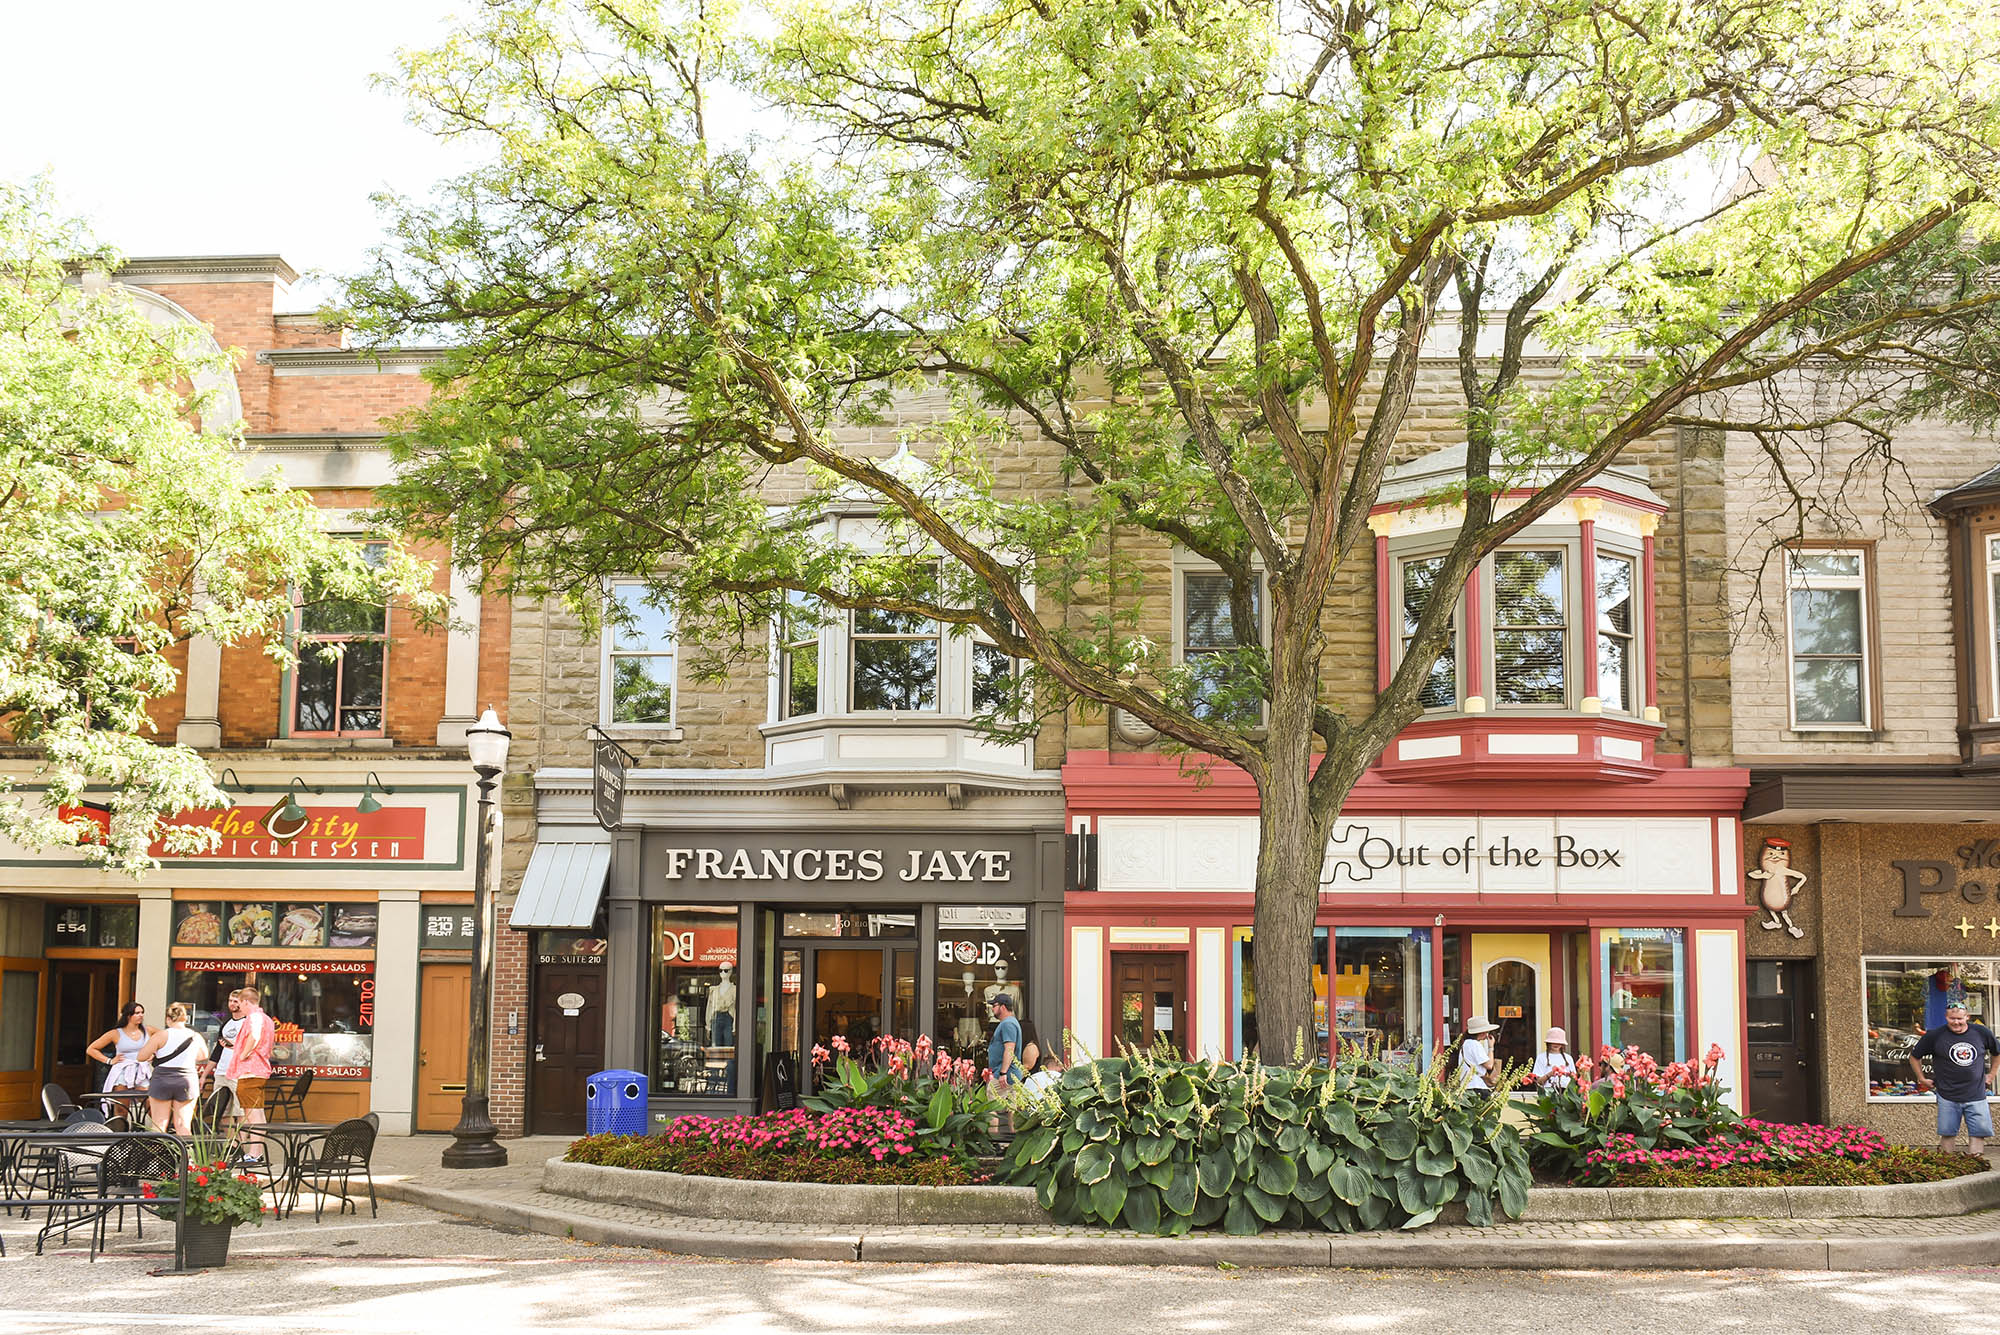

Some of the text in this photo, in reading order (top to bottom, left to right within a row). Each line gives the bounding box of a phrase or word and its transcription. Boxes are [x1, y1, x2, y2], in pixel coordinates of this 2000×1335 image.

[600, 764, 621, 790] FRANCES
[211, 806, 359, 848] the City
[1358, 835, 1621, 874] Out of the Box
[665, 848, 1011, 882] FRANCES JAYE
[57, 923, 87, 933] E 54
[428, 922, 453, 931] 210
[185, 961, 366, 972] PIZZAS PANINIS WRAPS SUBS SALADS
[561, 955, 587, 963] SUITE
[588, 955, 601, 963] 210
[360, 980, 375, 1026] OPEN
[271, 1066, 288, 1075] APS
[326, 1068, 362, 1077] SALADS
